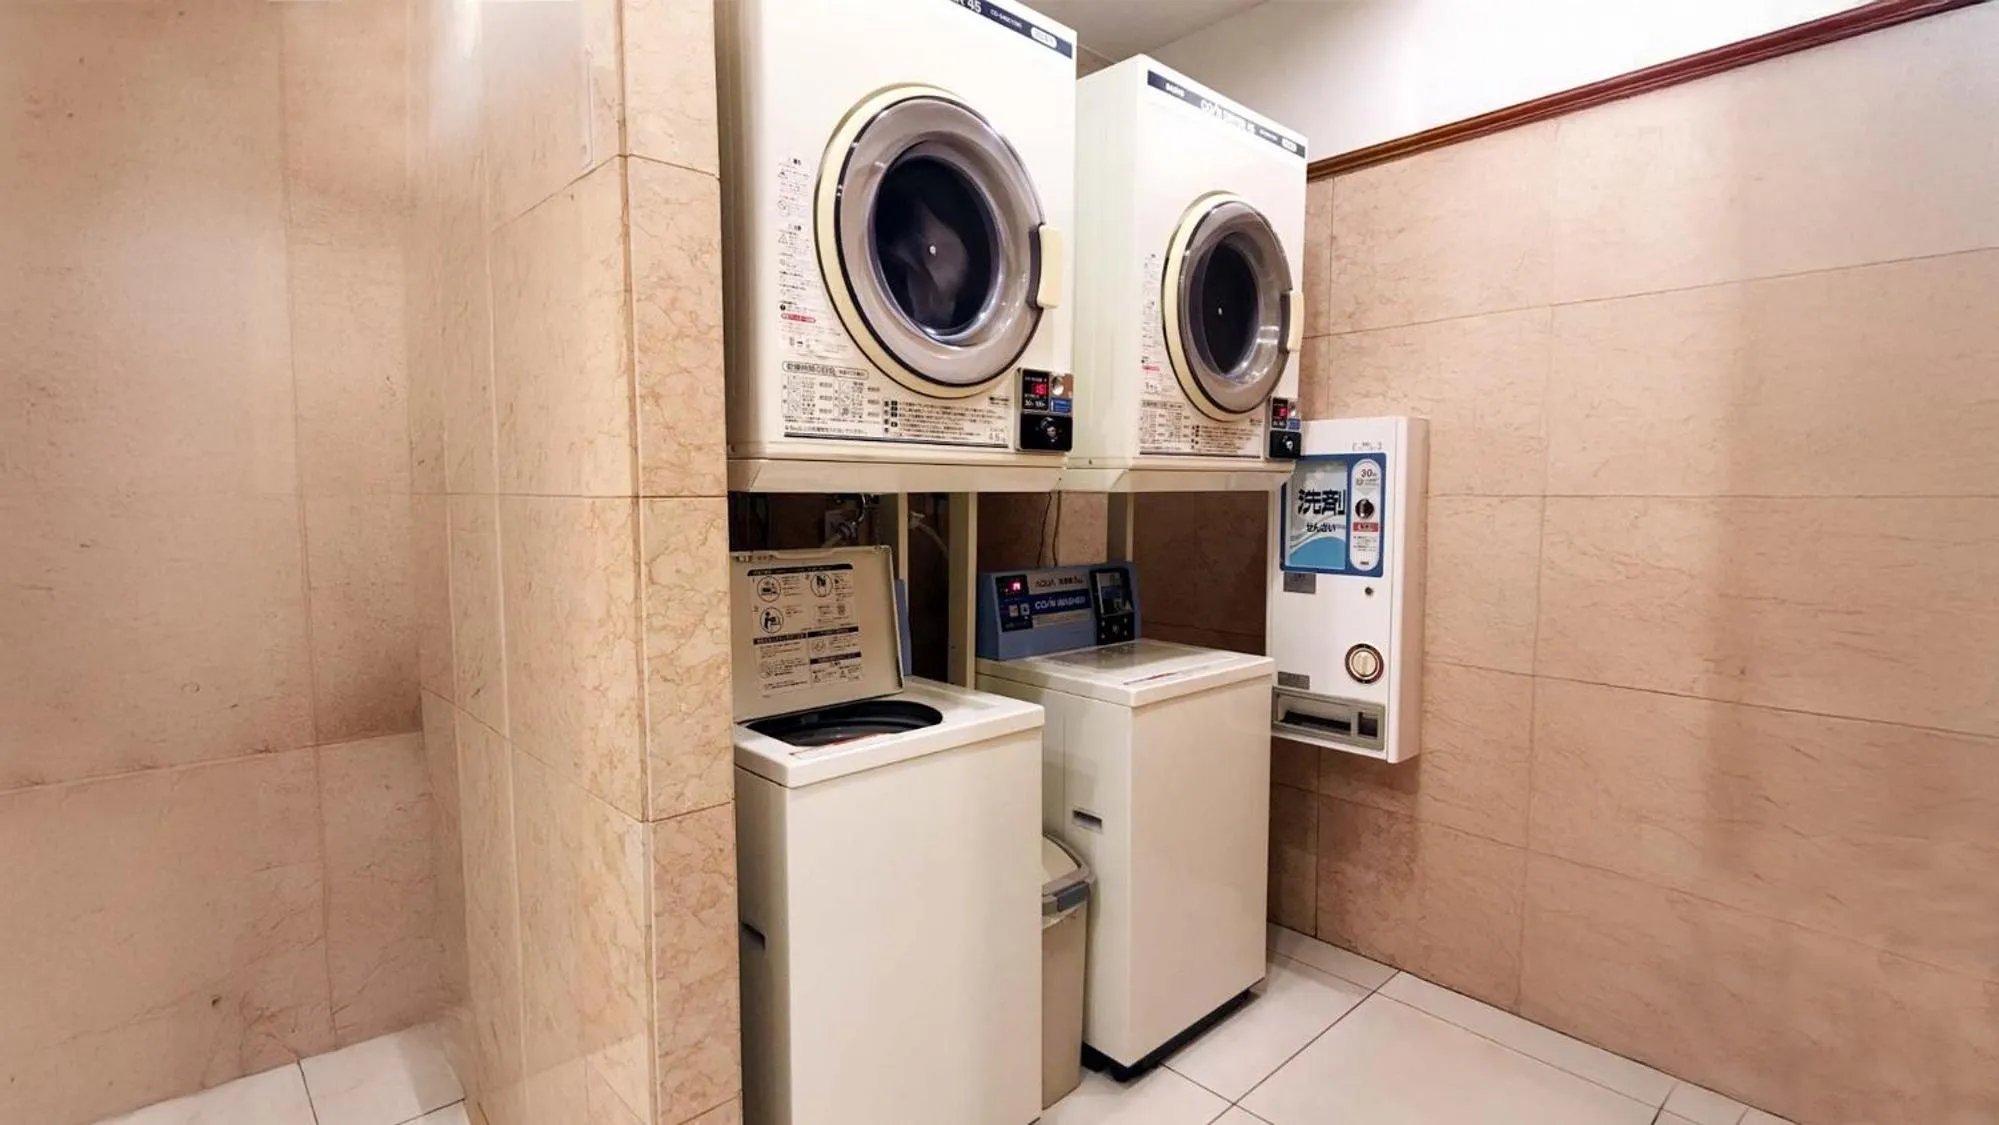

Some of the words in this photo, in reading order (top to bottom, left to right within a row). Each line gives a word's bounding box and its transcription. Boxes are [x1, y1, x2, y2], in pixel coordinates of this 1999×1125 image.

[1297, 488, 1346, 517] 洗剤
[1306, 521, 1337, 533] せんざい
